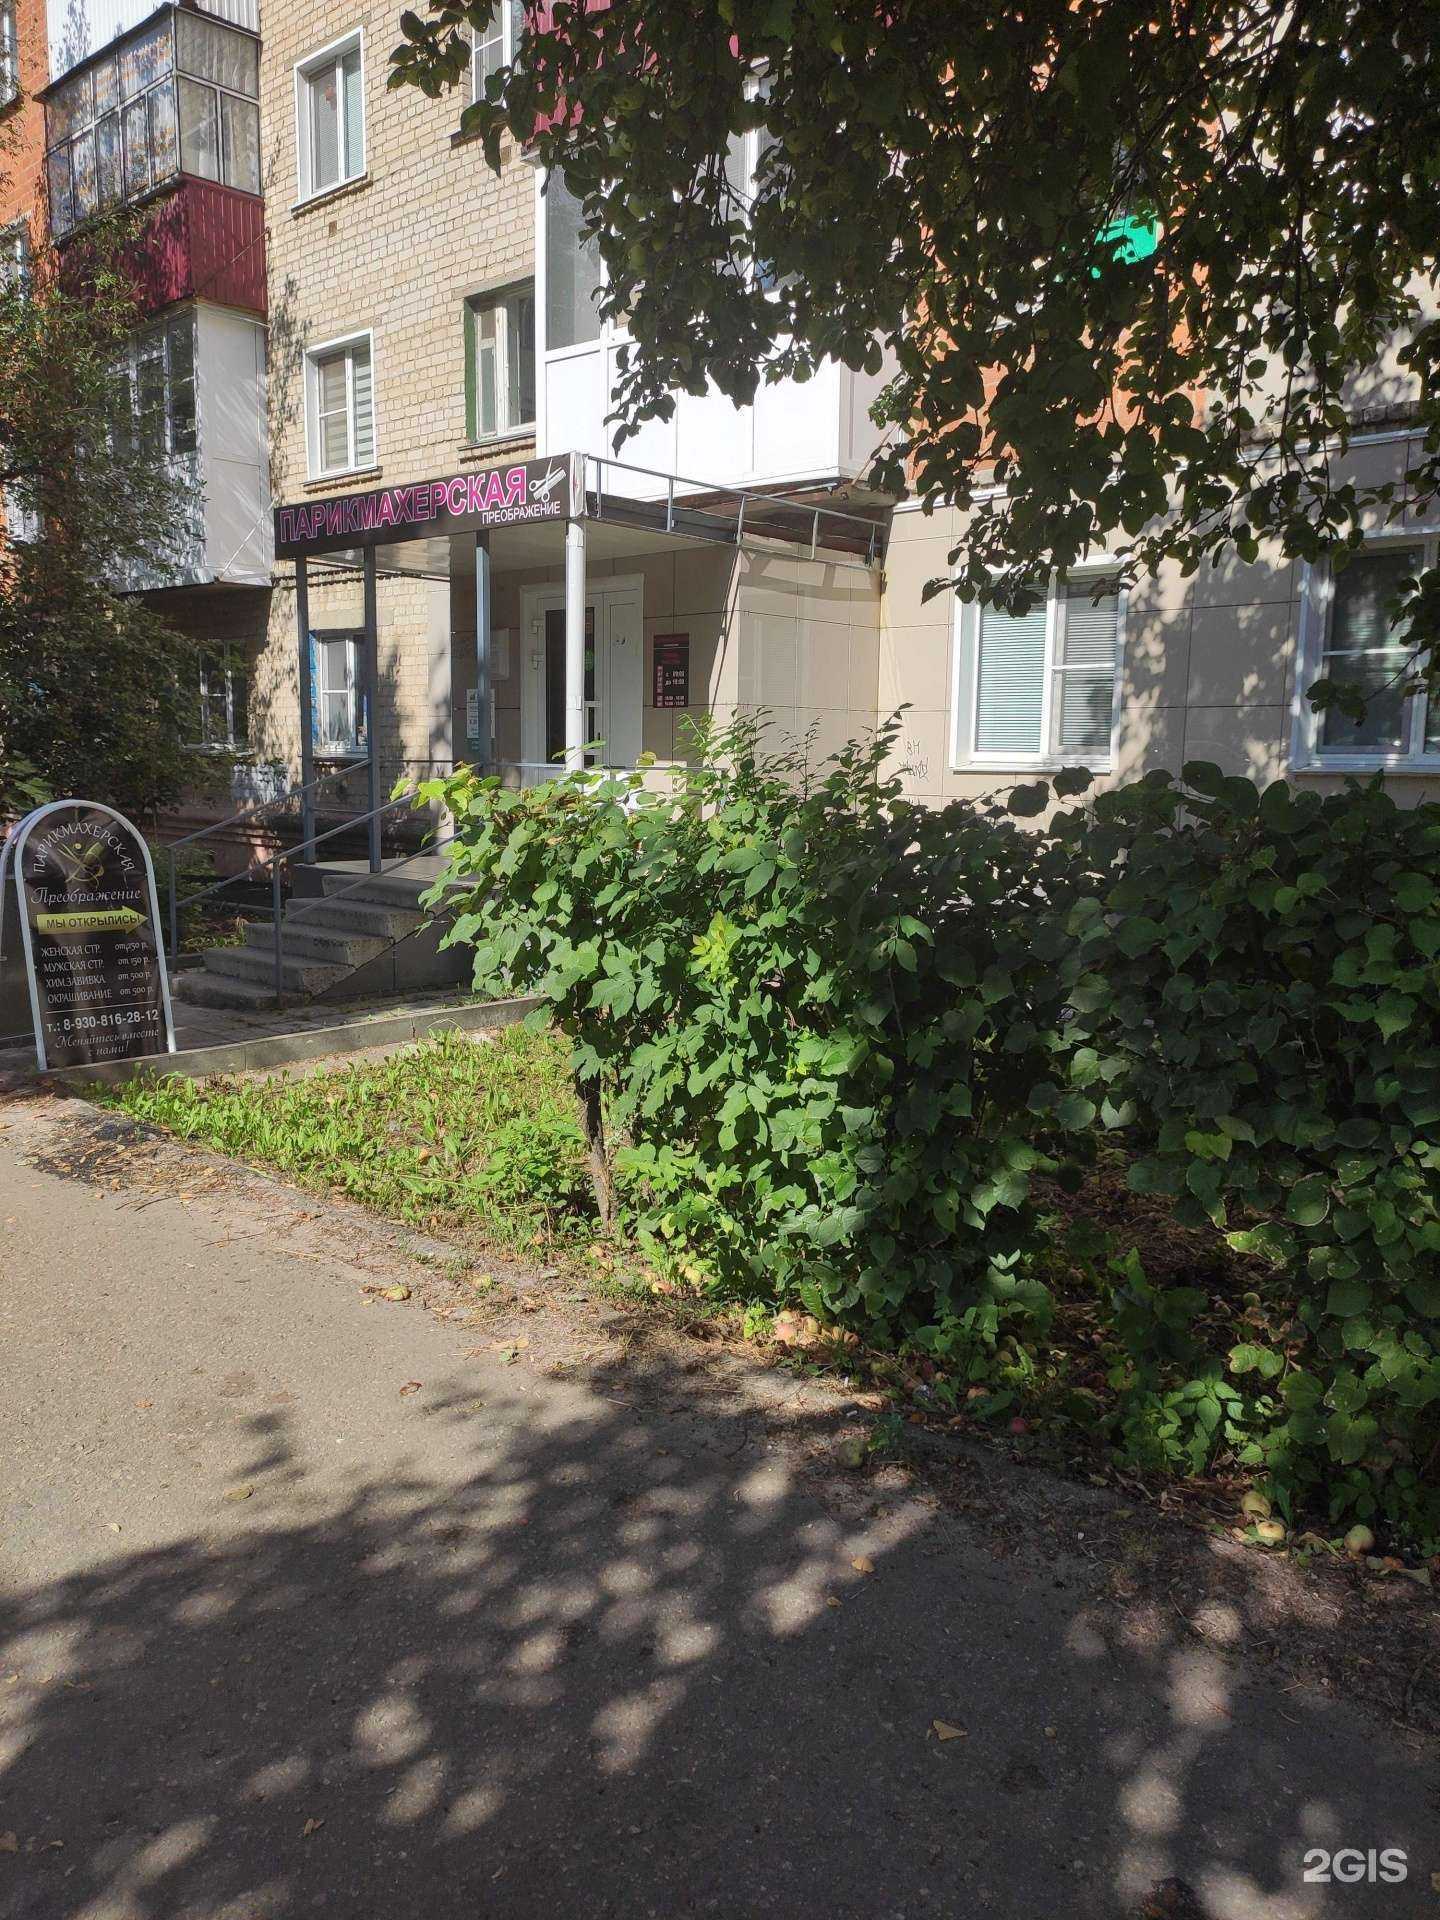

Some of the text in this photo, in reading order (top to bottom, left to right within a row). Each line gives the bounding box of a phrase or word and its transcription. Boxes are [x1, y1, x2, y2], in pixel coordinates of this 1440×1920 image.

[279, 465, 527, 543] ПАРИКМАХЕРСКАЯ
[482, 500, 561, 525] ПРЕОБРАЖЕНИЕ
[33, 822, 135, 873] ПАРИКМАХЕРСКАЯ
[31, 887, 142, 906] Преображение
[46, 914, 141, 929] МЫ ОТКРЫЛИСЬ!
[41, 945, 83, 958] ЖЕНСКАЯ
[43, 960, 86, 973] МУЖСКАЯ
[118, 957, 129, 965] от
[118, 973, 129, 981] от
[47, 988, 113, 1004] ОКРАШИВАНИЕ
[119, 988, 131, 996] от
[132, 986, 145, 997] 500
[63, 1009, 159, 1030] 8-930-816-28-12
[55, 1033, 119, 1049] Меняйтесь
